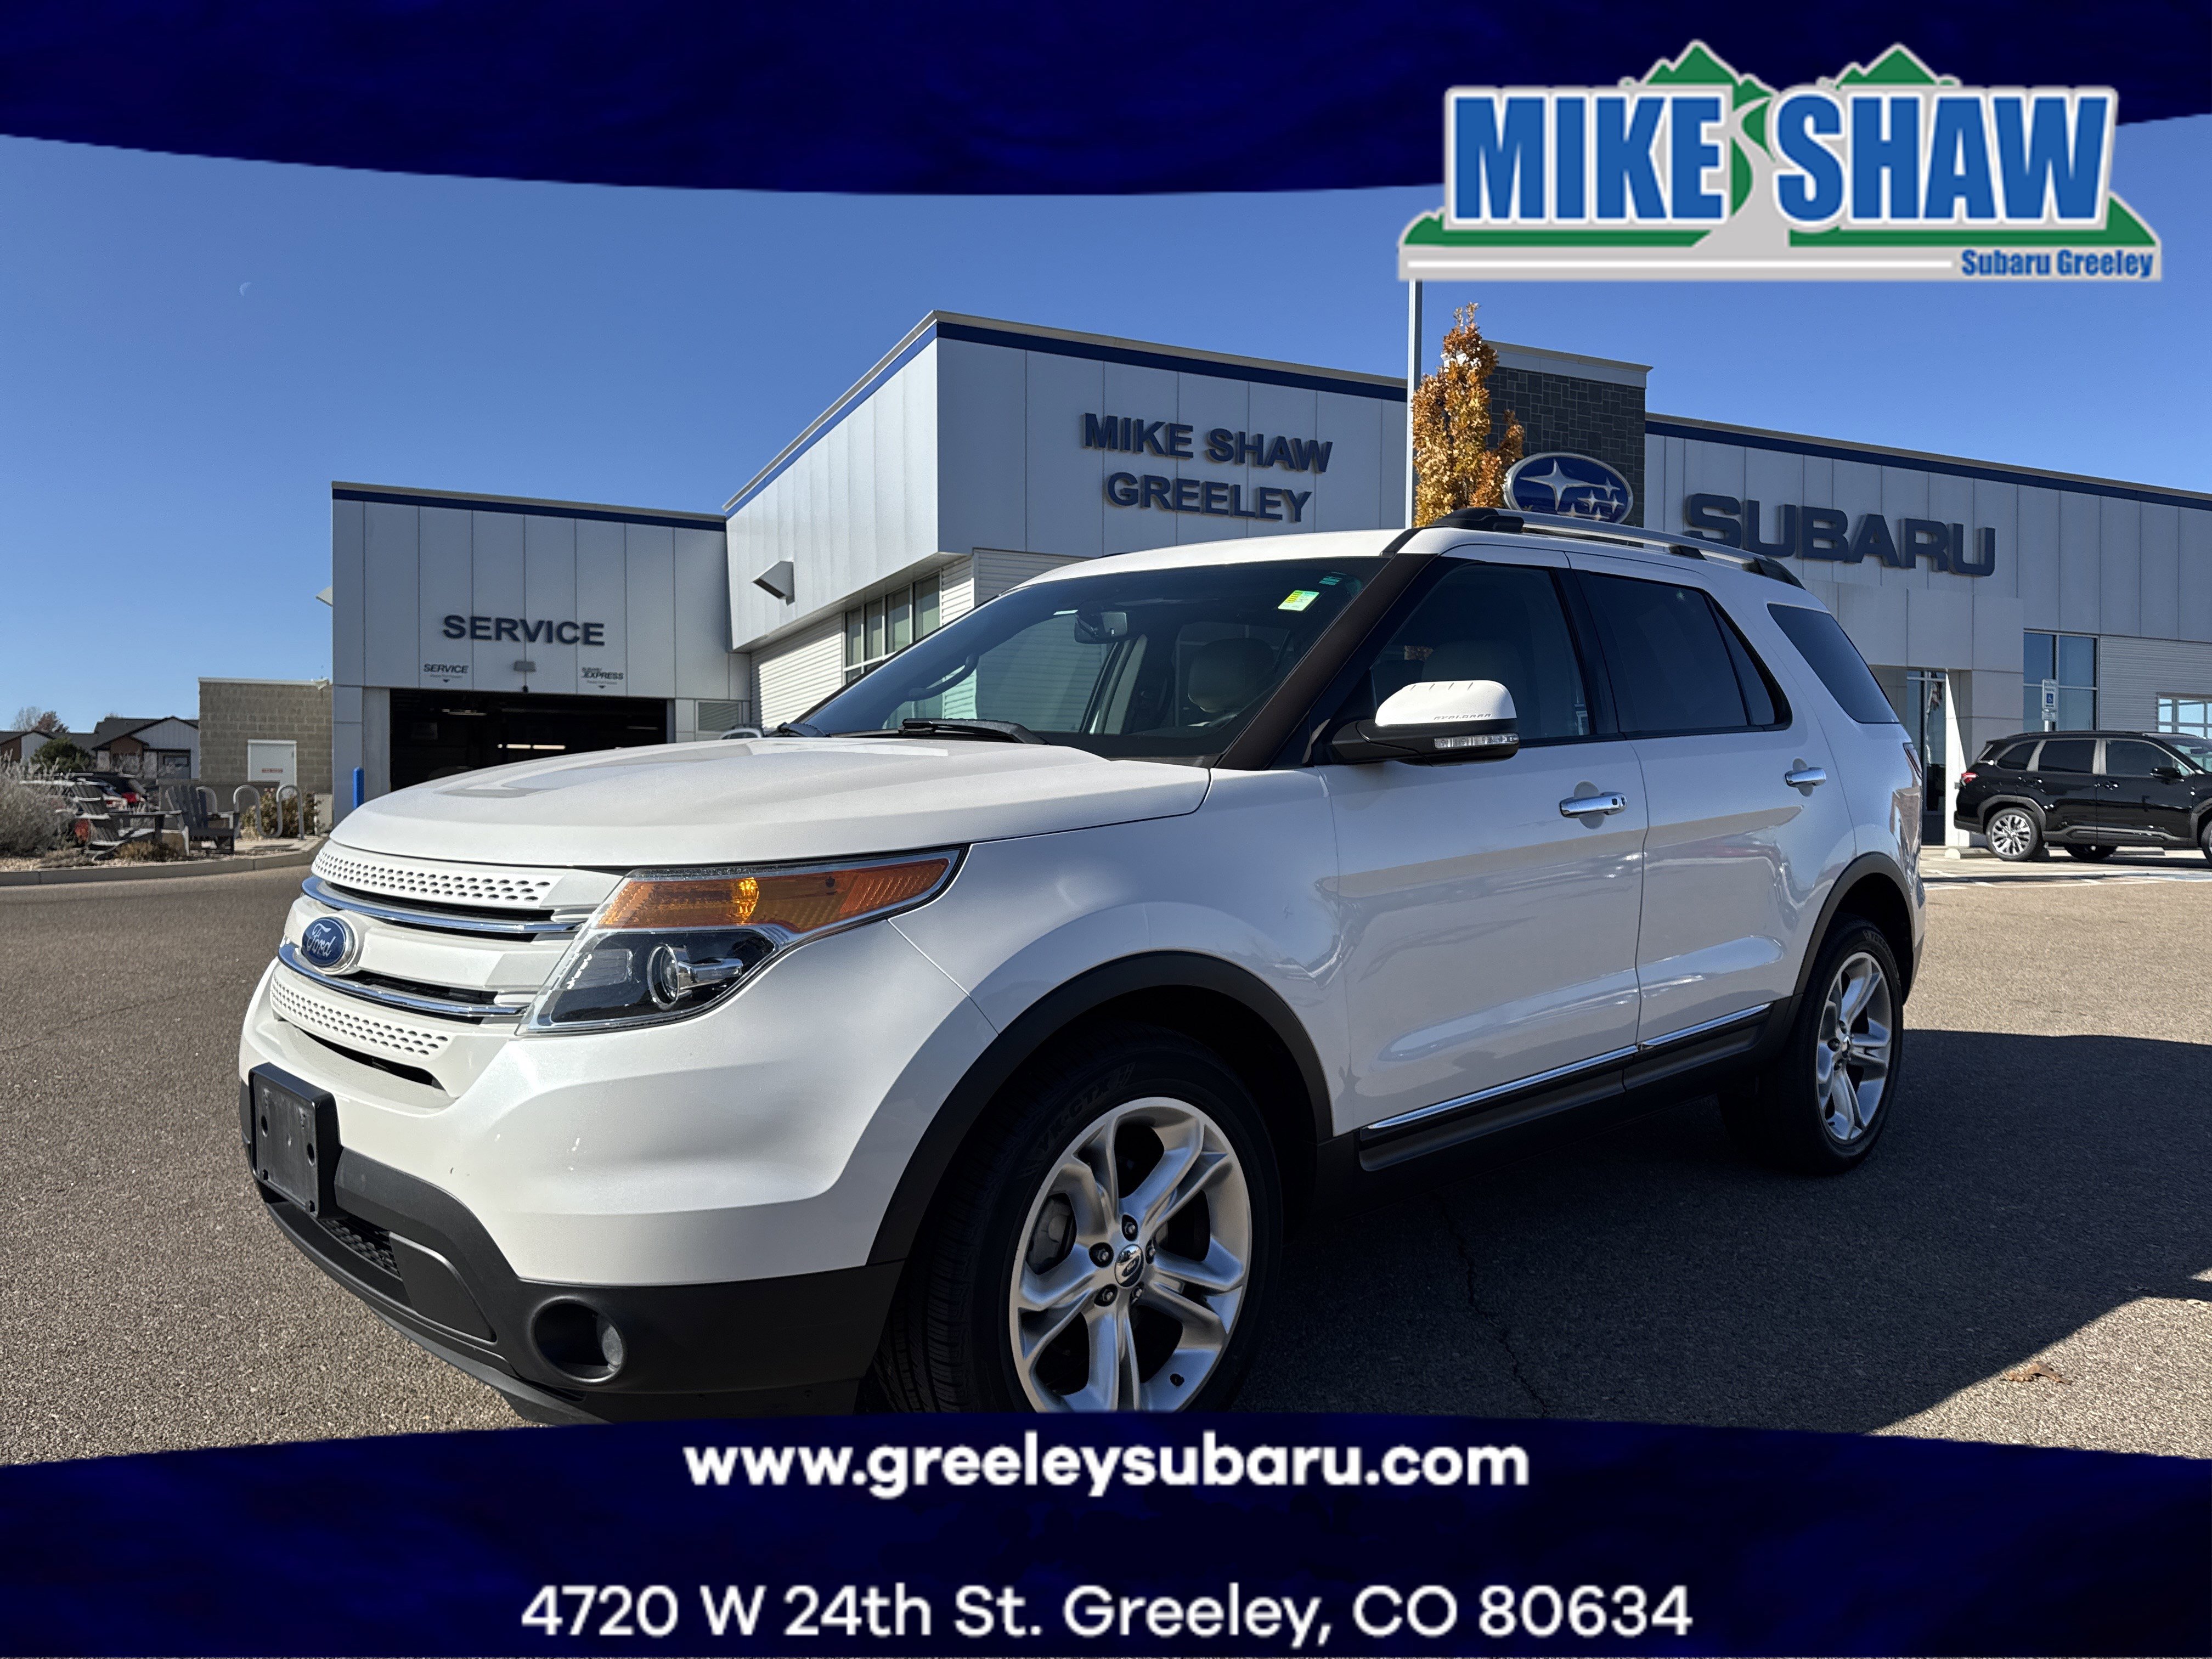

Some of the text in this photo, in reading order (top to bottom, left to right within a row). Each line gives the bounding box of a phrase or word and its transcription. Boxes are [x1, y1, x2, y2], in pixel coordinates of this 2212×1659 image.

[1083, 413, 1333, 473] MIKE SHAW
[1107, 472, 1312, 522] GREELEY
[1685, 493, 1996, 577] SUBARU
[443, 614, 605, 646] SERVICE
[424, 663, 469, 674] SERVICE
[307, 923, 336, 958] Ford
